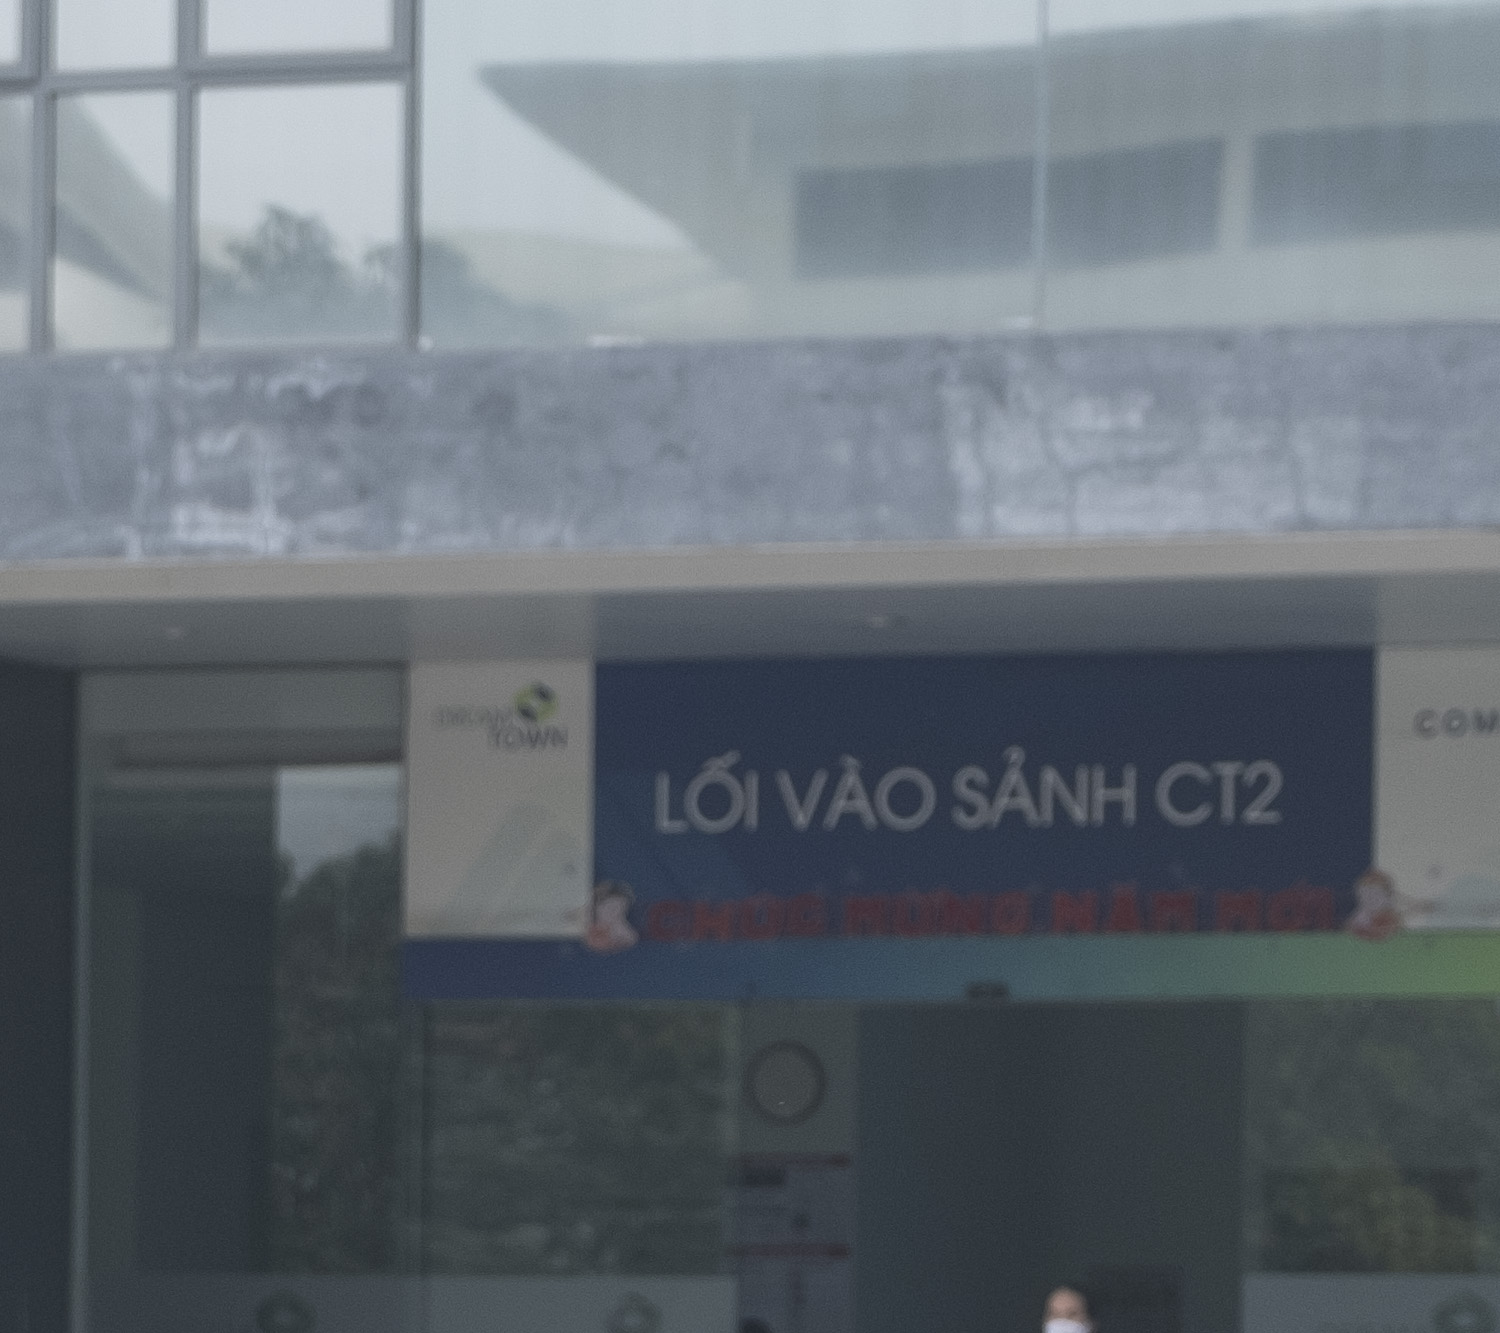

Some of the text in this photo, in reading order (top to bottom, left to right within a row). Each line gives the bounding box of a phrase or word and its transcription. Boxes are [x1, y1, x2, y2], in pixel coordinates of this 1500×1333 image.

[654, 745, 1284, 834] LỐI VÀO SẢNH CT2
